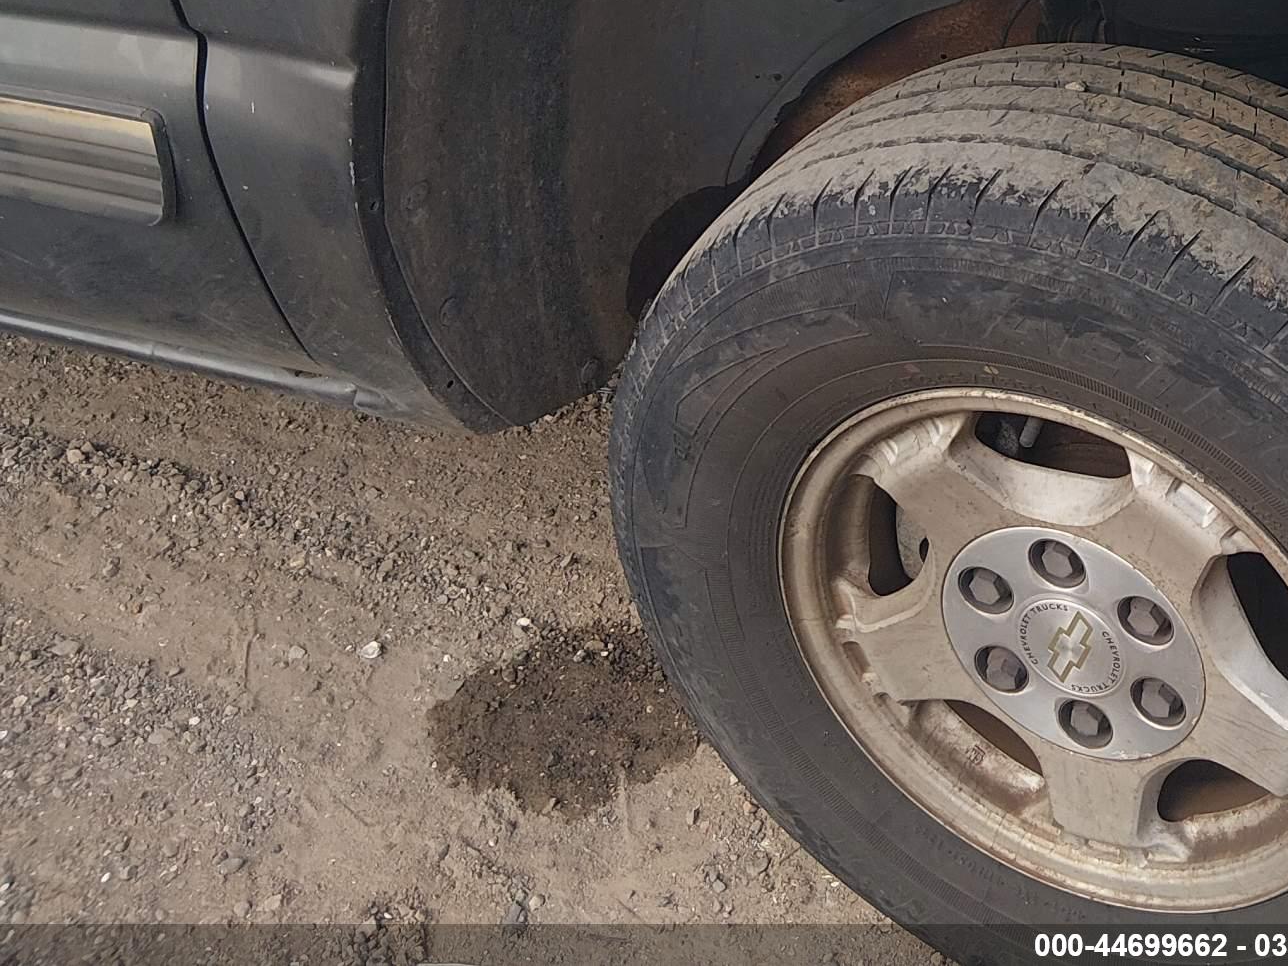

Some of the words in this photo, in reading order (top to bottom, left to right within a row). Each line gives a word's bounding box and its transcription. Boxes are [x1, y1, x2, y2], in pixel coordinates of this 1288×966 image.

[1019, 613, 1039, 665] CHEVROLET
[1029, 603, 1069, 614] TRUCKS
[1101, 631, 1121, 684] CHEVROLET
[1071, 682, 1110, 693] TRUCKS
